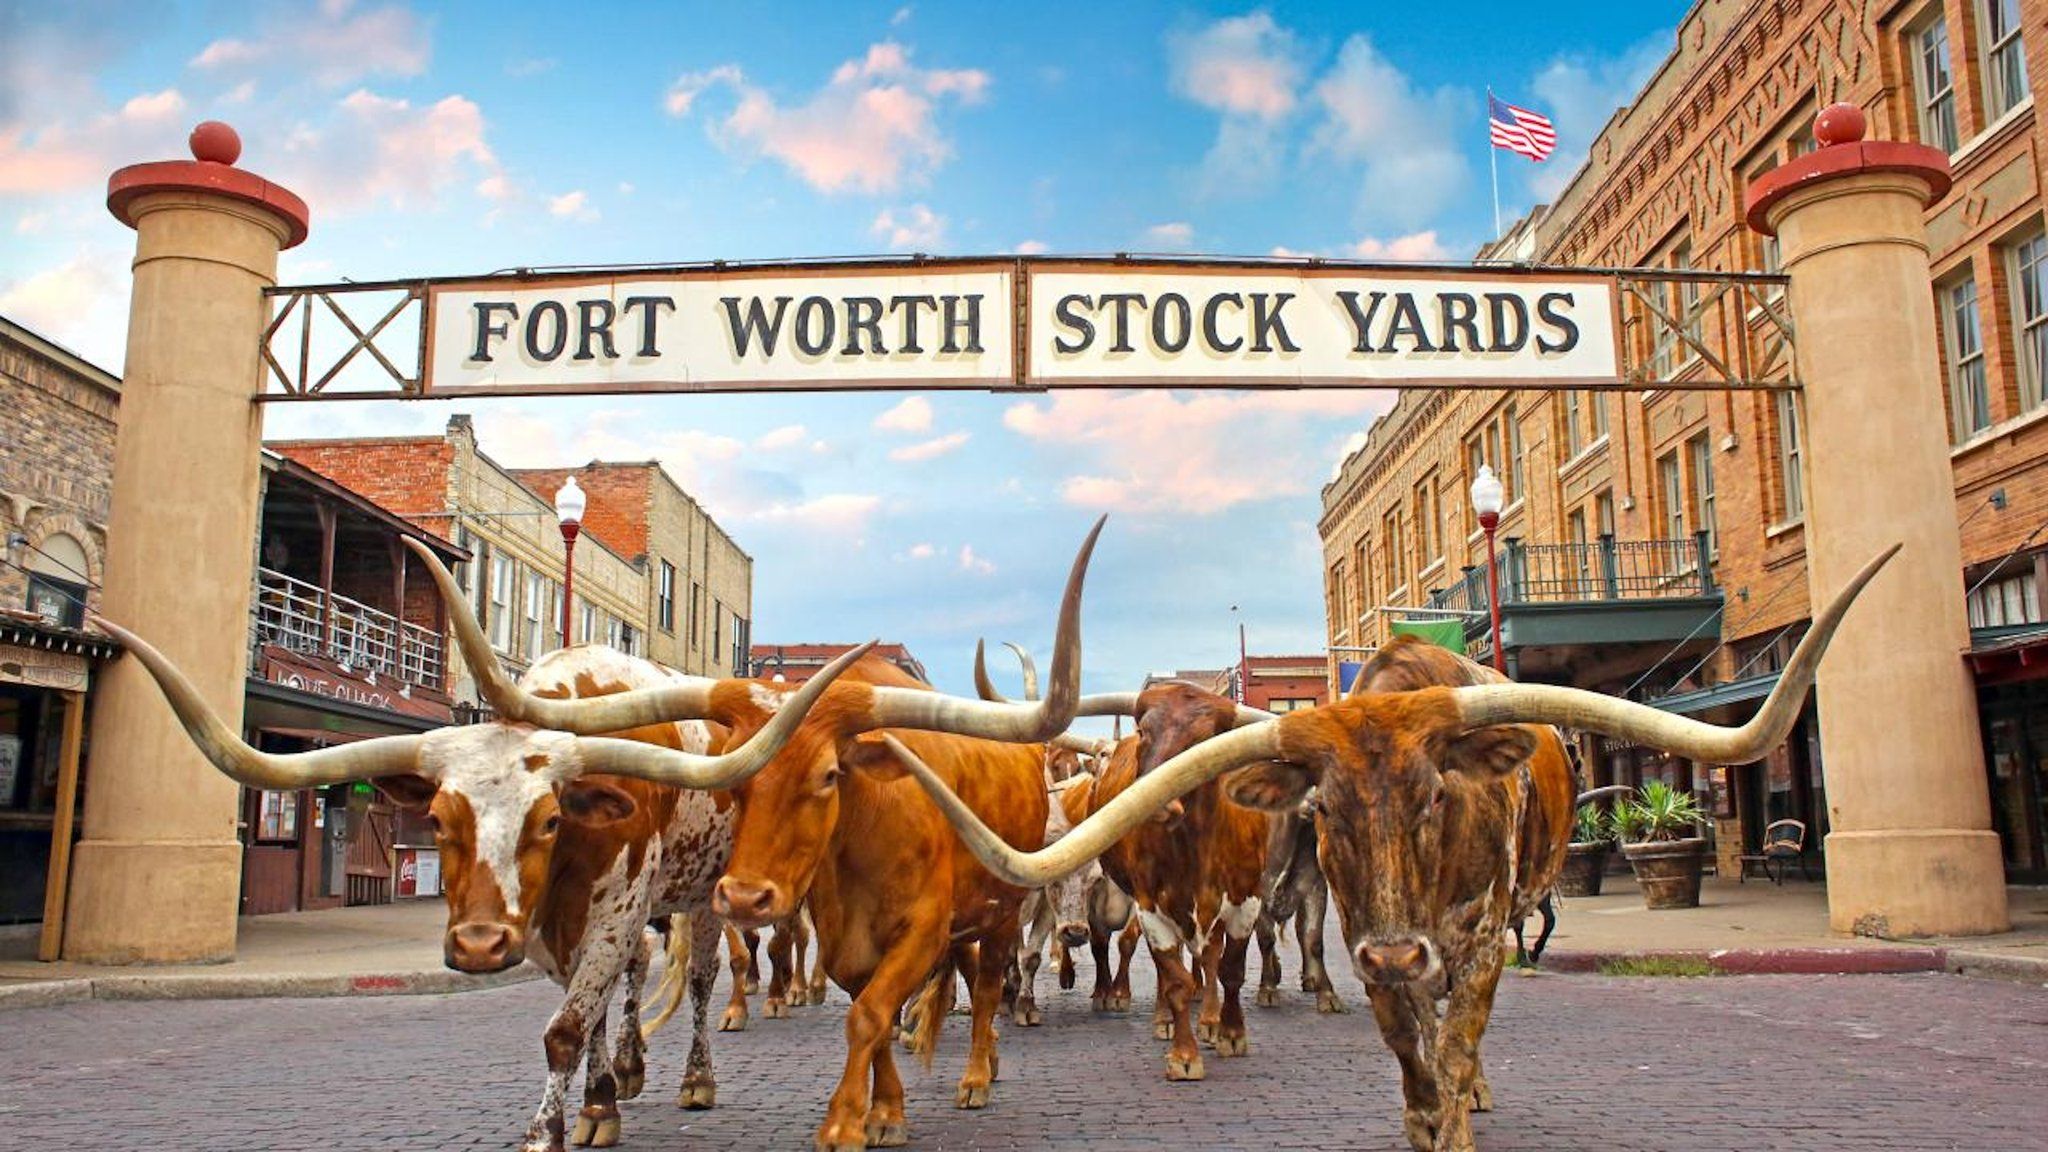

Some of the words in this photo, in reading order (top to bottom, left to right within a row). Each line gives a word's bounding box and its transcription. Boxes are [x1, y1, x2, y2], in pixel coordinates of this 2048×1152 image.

[470, 296, 676, 362] FORT
[719, 294, 985, 358] WORTH
[1054, 292, 1301, 354] STOCK
[1336, 291, 1580, 355] YARDS
